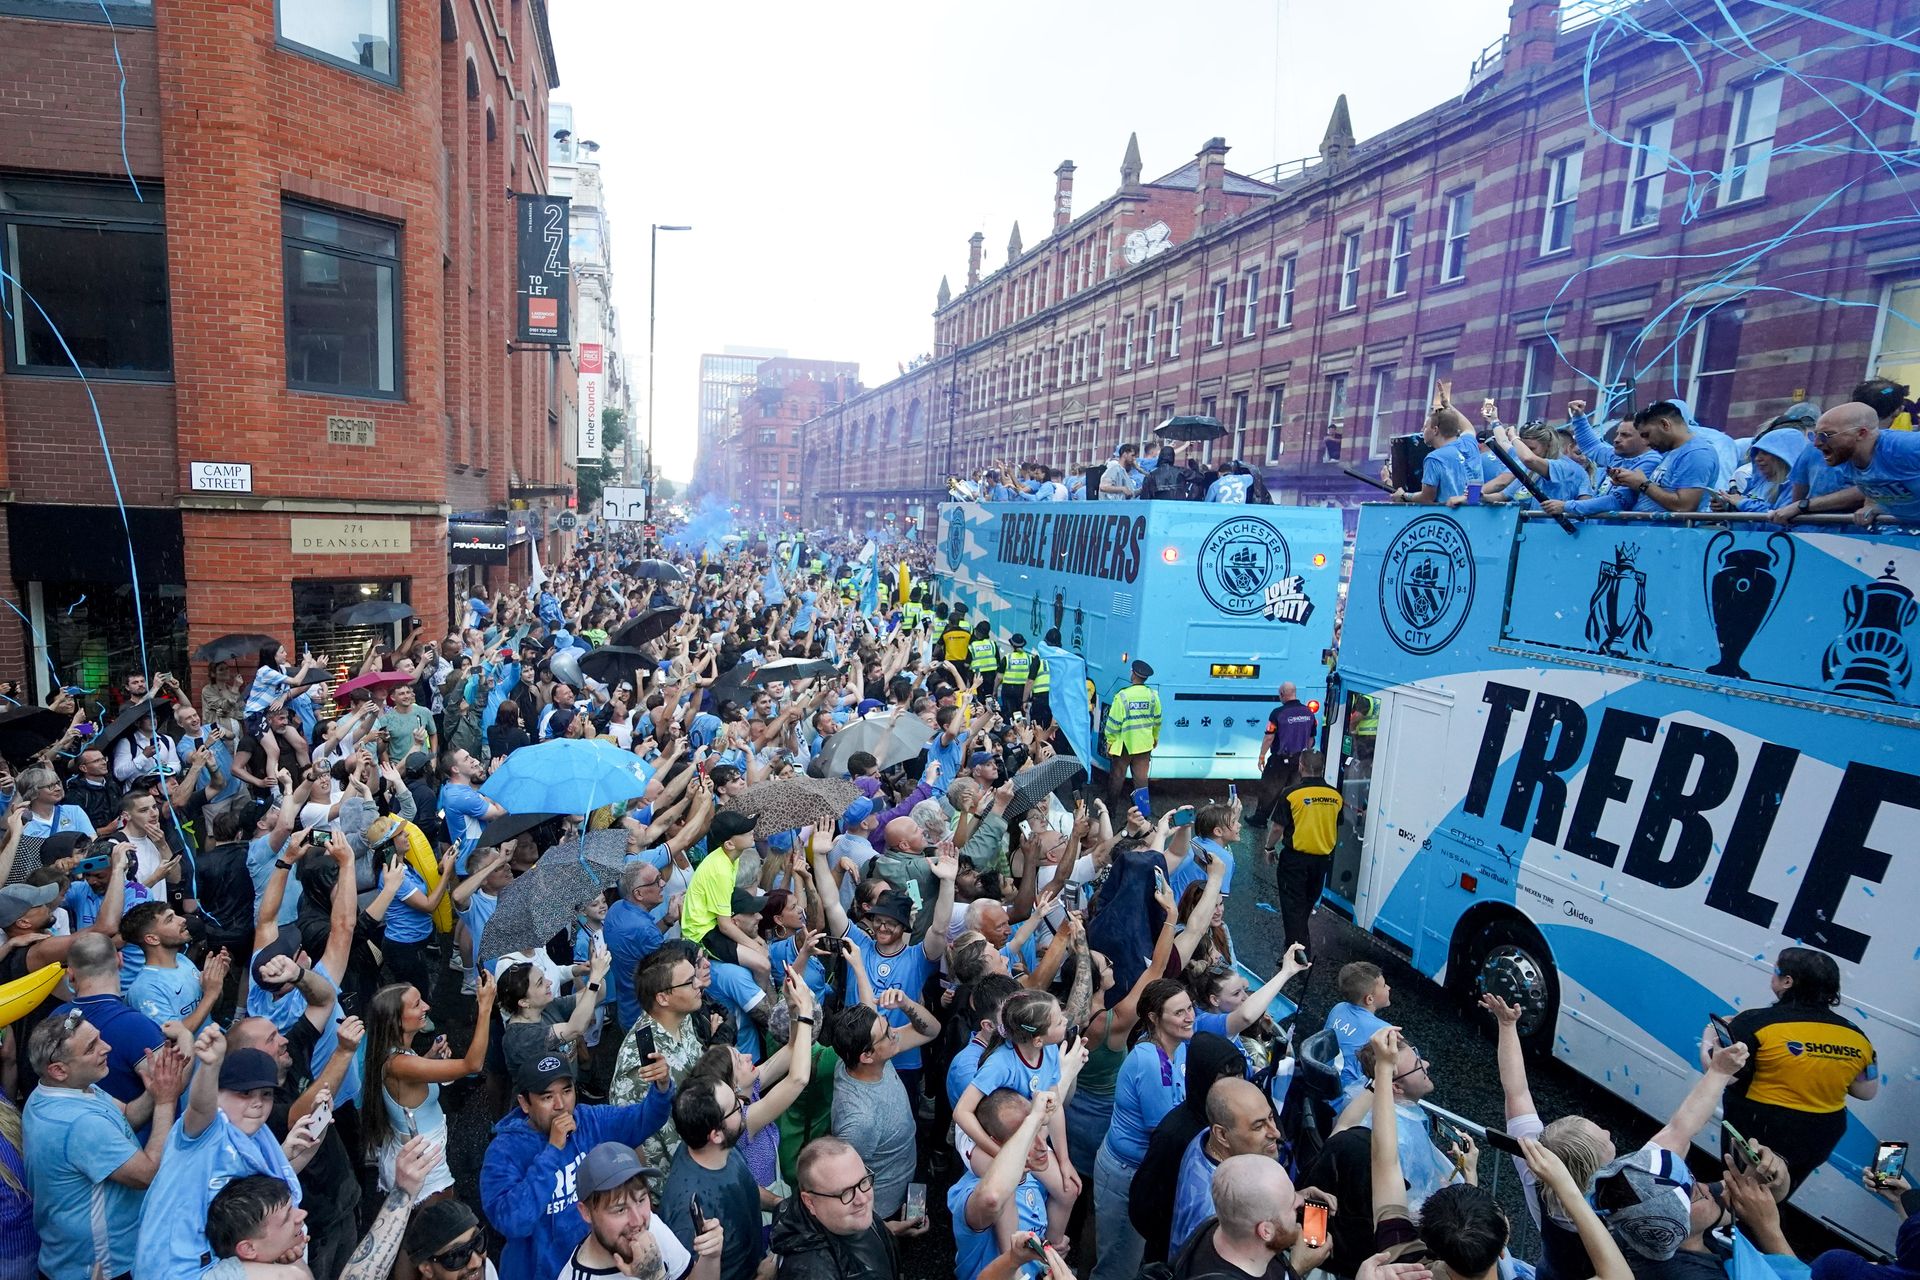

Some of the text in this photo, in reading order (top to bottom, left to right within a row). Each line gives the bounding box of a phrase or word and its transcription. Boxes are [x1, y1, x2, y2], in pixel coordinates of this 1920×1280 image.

[529, 275, 542, 285] TO
[529, 286, 548, 296] LET
[586, 381, 596, 448] richersounds
[203, 464, 242, 477] CAMP
[199, 477, 247, 490] STREET
[1219, 481, 1244, 504] 23
[343, 524, 363, 534] 274
[303, 538, 400, 548] DEANSGATE
[453, 542, 506, 550] PINARELLO
[997, 512, 1052, 568] TREBLE
[1049, 513, 1147, 584] WINNERS
[1209, 523, 1281, 555] MANCHESTER
[1392, 525, 1466, 571] MANCHESTER
[1263, 575, 1303, 603] LOVE
[1387, 577, 1394, 585] 18
[1228, 598, 1255, 608] CITY
[1273, 600, 1309, 621] CITY
[1404, 629, 1432, 645] CITY
[1129, 702, 1149, 710] POLICE
[1462, 680, 1920, 964] TREBLE
[1450, 828, 1485, 847] ETIHAD
[1440, 849, 1471, 867] NISSAN
[1524, 886, 1542, 899] NEXEN
[1542, 895, 1555, 905] TIRE
[1562, 901, 1594, 925] Midea
[1332, 1018, 1357, 1036] KAI
[1805, 1042, 1862, 1059] SHOWSEC
